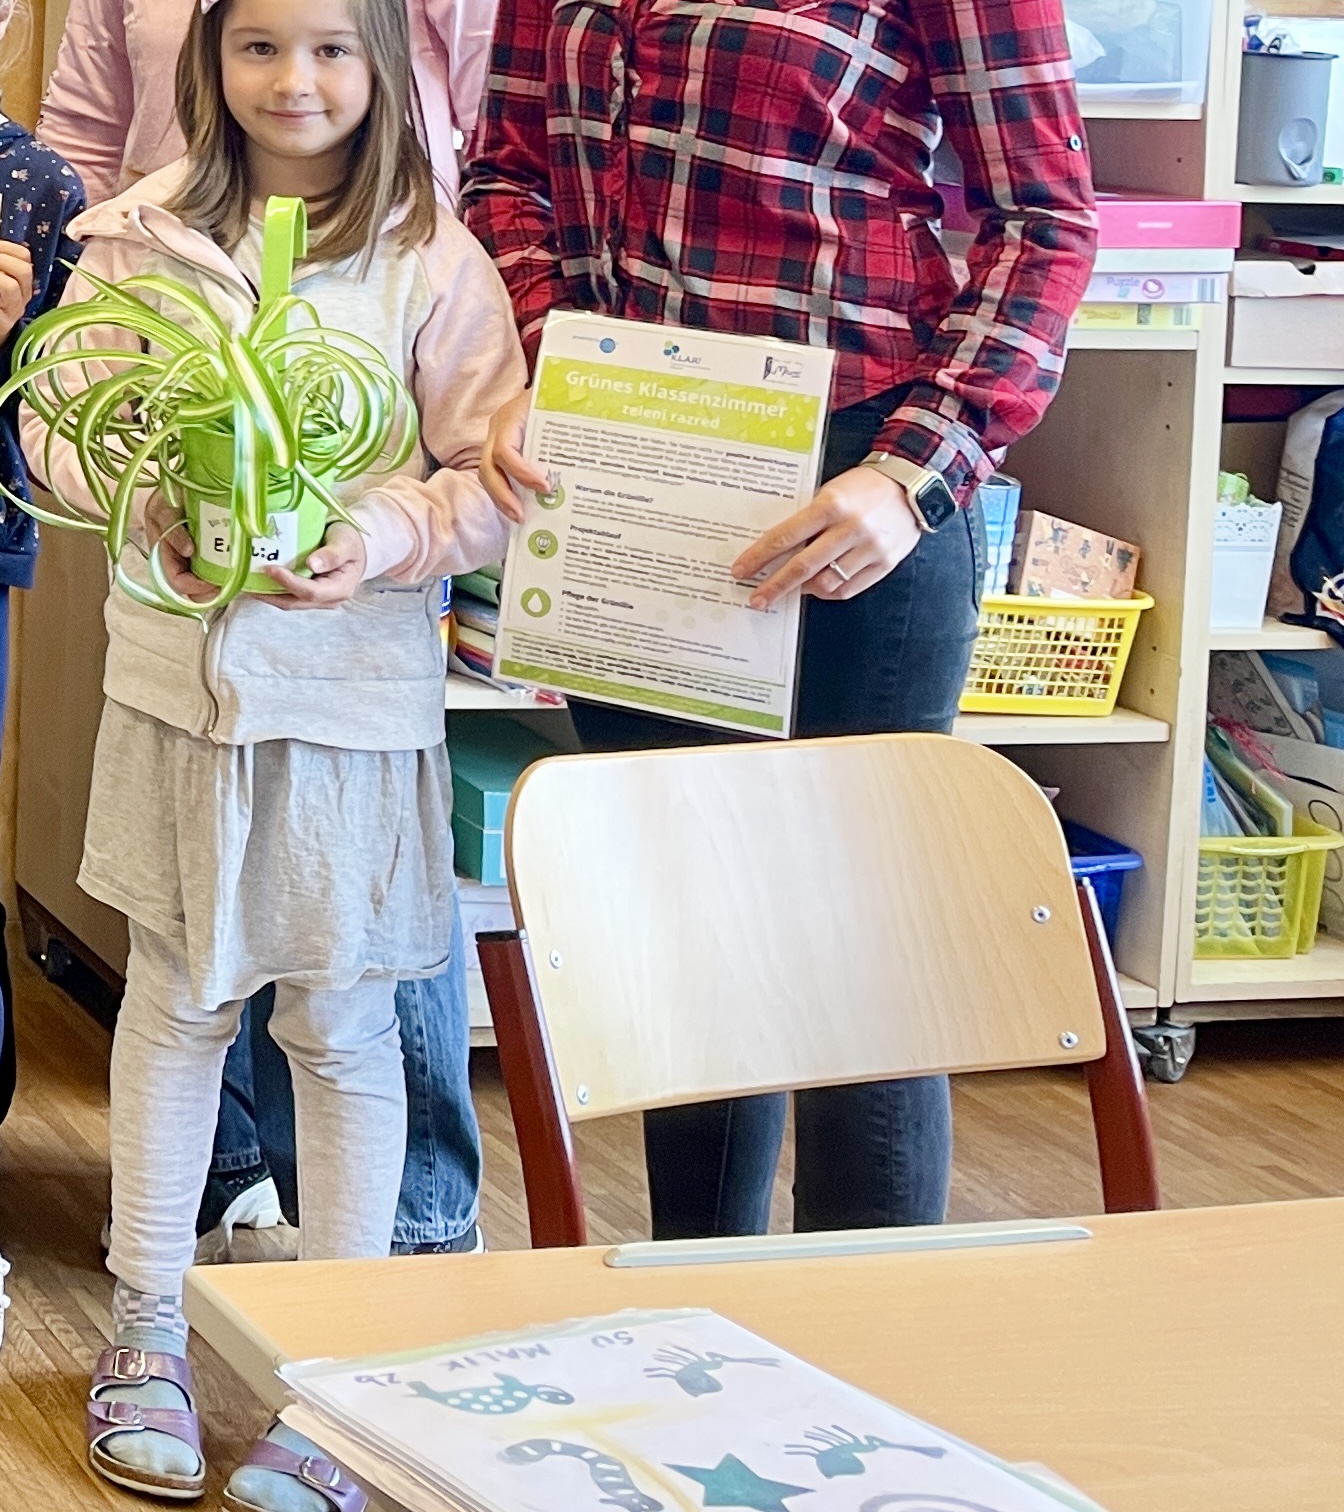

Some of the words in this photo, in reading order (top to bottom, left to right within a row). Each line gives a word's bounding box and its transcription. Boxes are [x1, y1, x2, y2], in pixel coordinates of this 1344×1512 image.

[565, 369, 633, 394] Grünes
[638, 380, 789, 418] Klassenzimmer
[670, 409, 721, 430] razred
